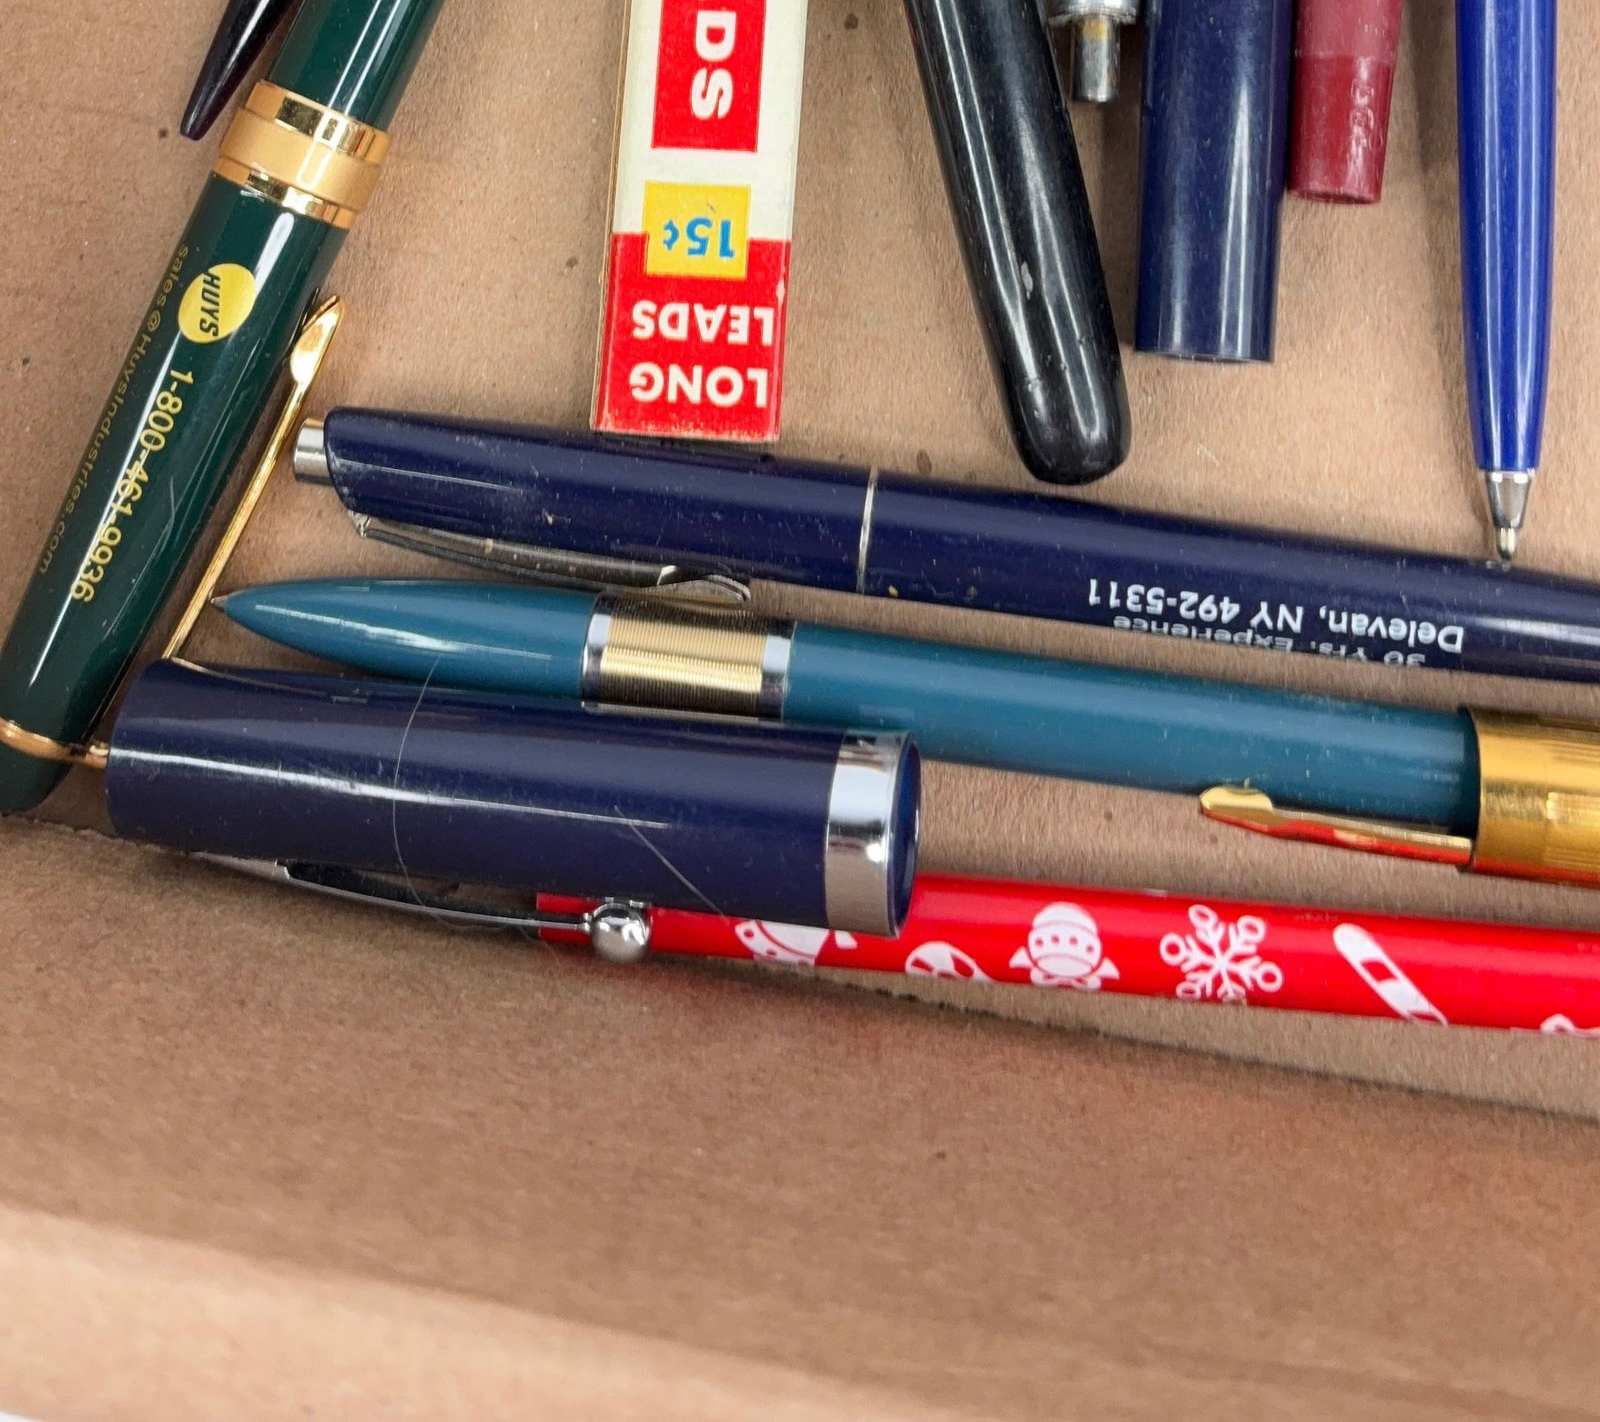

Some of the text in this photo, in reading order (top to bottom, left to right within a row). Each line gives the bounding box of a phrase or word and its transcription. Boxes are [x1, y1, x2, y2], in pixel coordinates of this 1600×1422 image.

[661, 215, 736, 260] 15¢
[199, 268, 222, 339] HUYS
[632, 302, 775, 346] LEADS
[628, 361, 769, 409] LONG
[71, 368, 194, 603] 1-800-461-9936
[1087, 578, 1465, 654] Delevan, NY 492-5311
